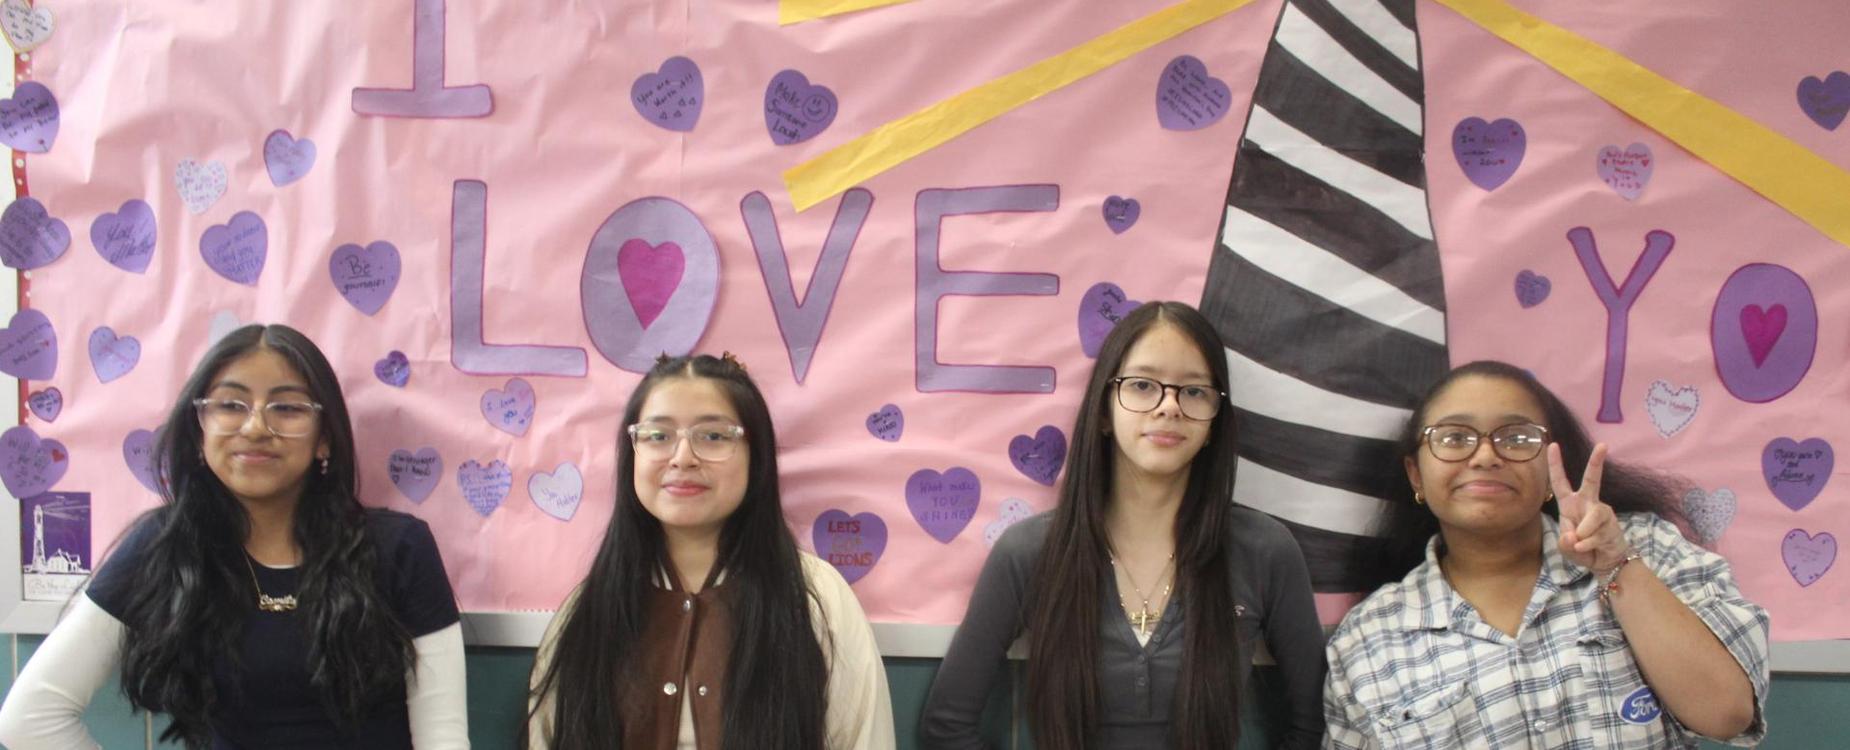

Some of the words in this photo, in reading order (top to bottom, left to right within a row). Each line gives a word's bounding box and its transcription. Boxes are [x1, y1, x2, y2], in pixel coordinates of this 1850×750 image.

[345, 254, 371, 275] Be
[451, 178, 1060, 394] LOVE
[932, 496, 960, 508] YOU
[827, 520, 861, 534] LETS
[828, 551, 873, 567] LIONS
